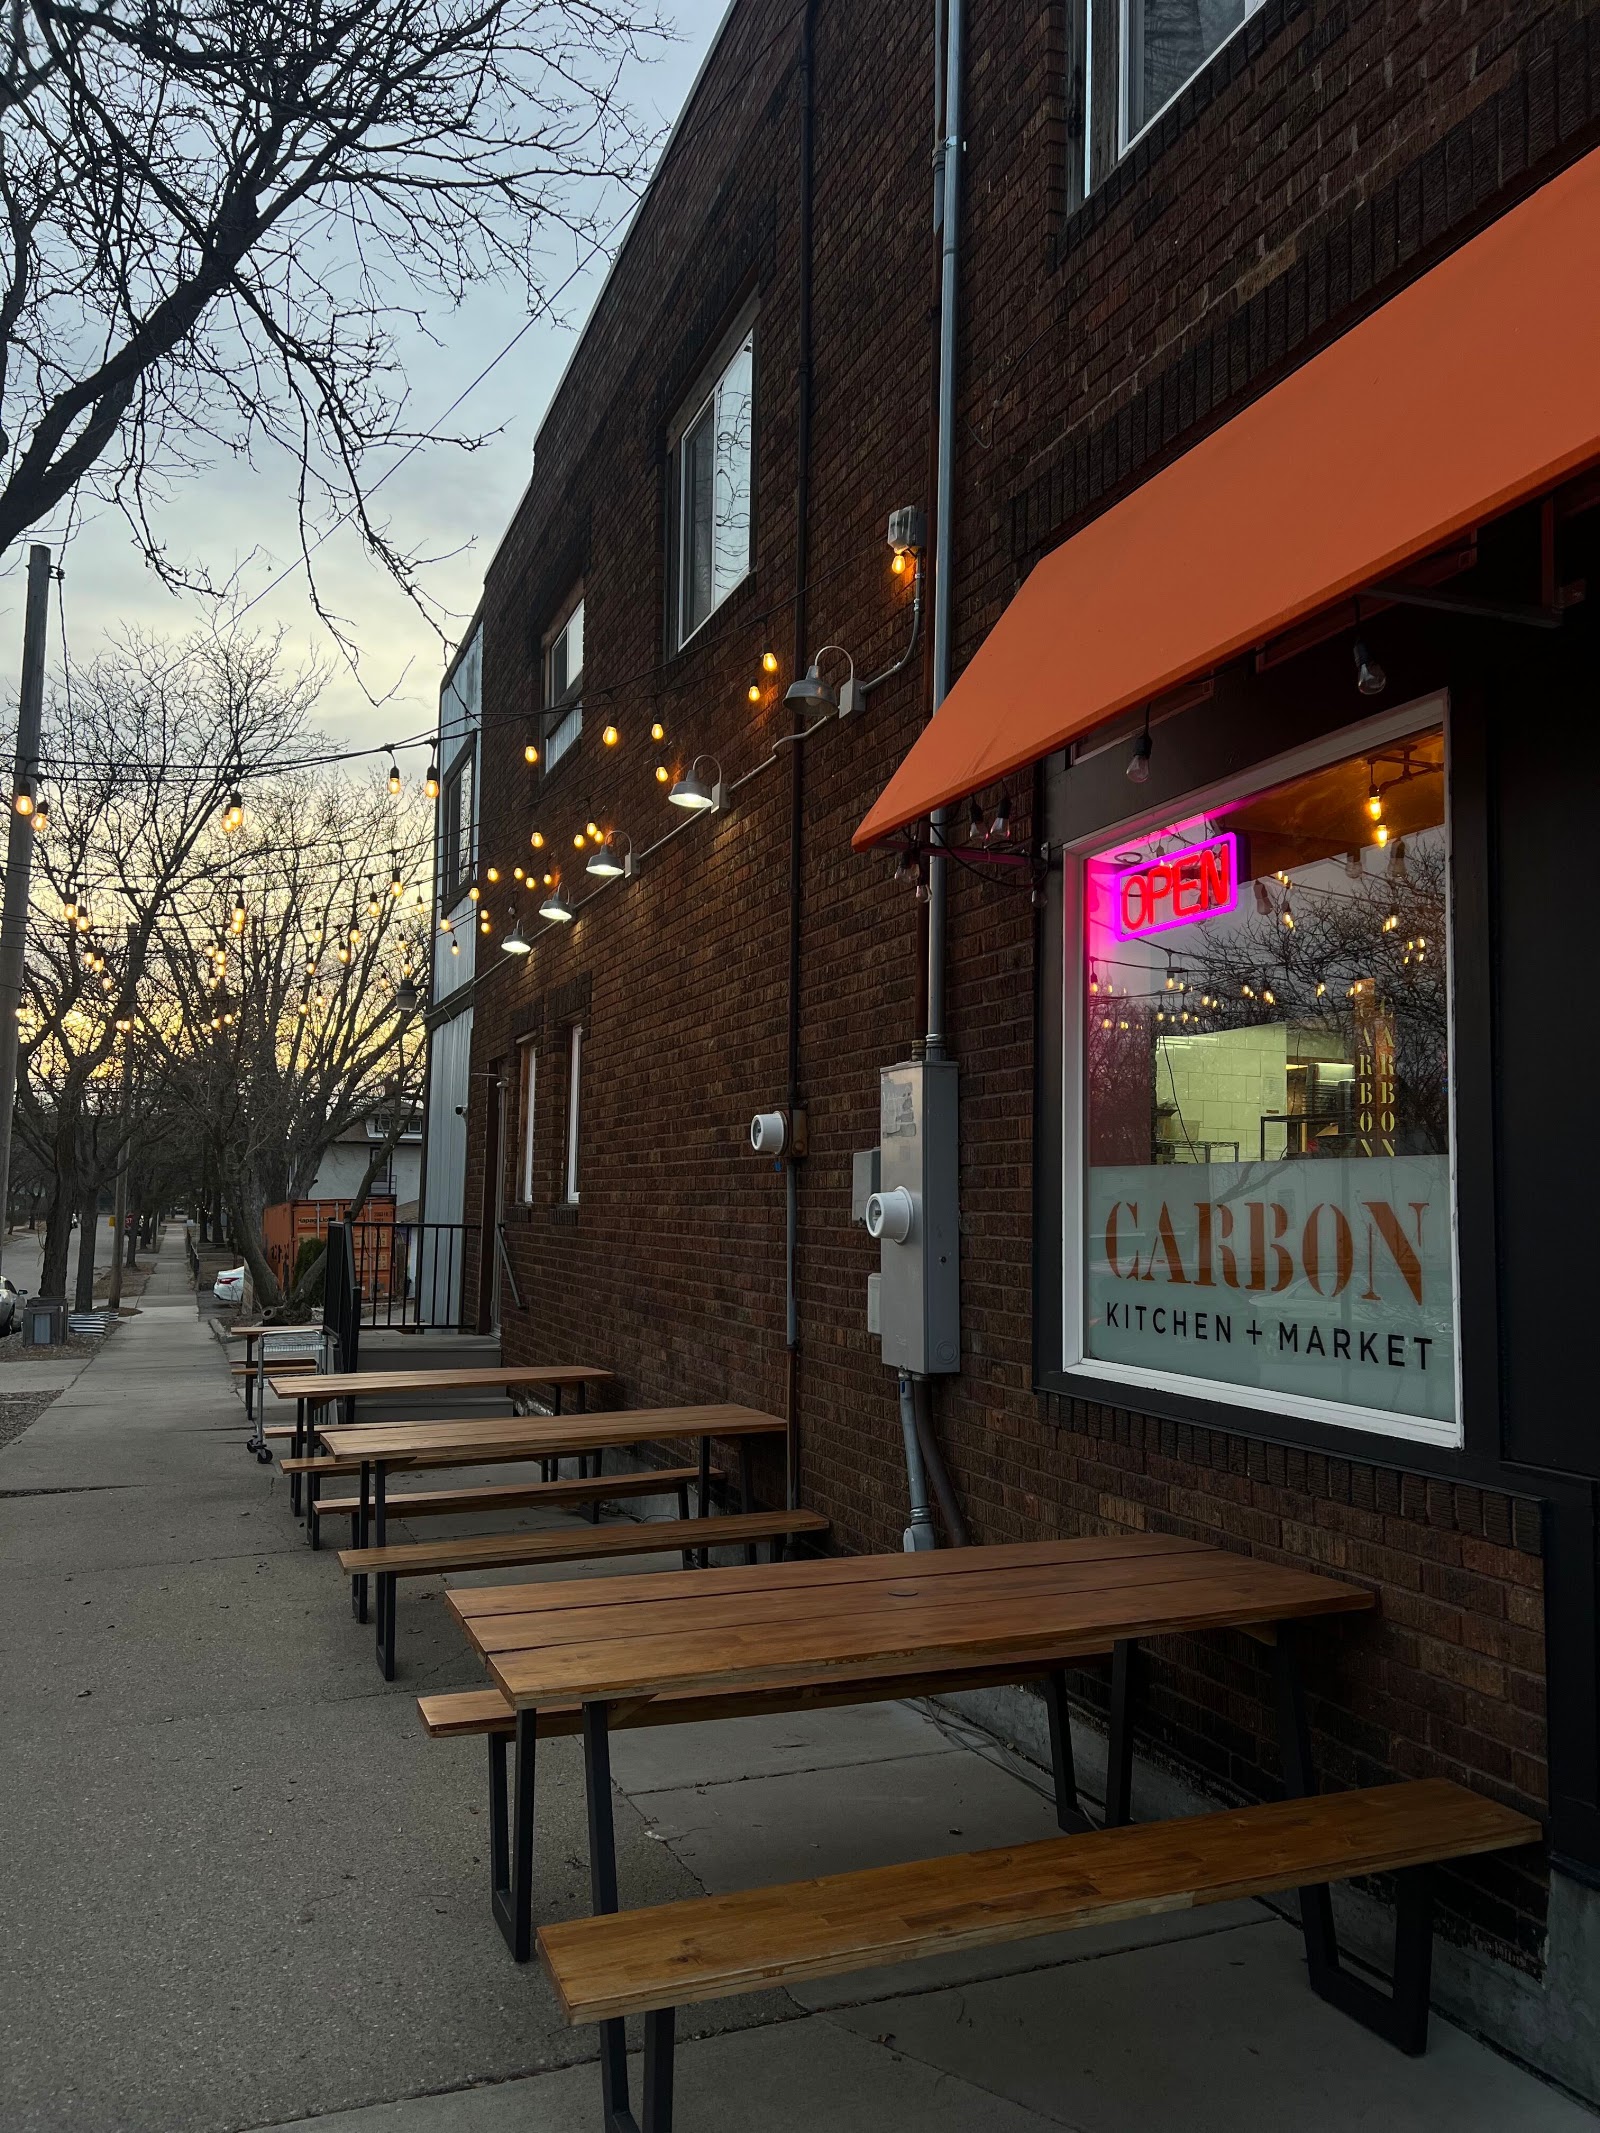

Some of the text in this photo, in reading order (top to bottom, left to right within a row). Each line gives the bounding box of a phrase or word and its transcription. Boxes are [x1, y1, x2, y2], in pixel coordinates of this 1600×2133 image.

[1122, 844, 1229, 931] OPEN
[1105, 1201, 1430, 1306] CARBON
[1106, 1302, 1433, 1371] KITCHEN + MARKET
